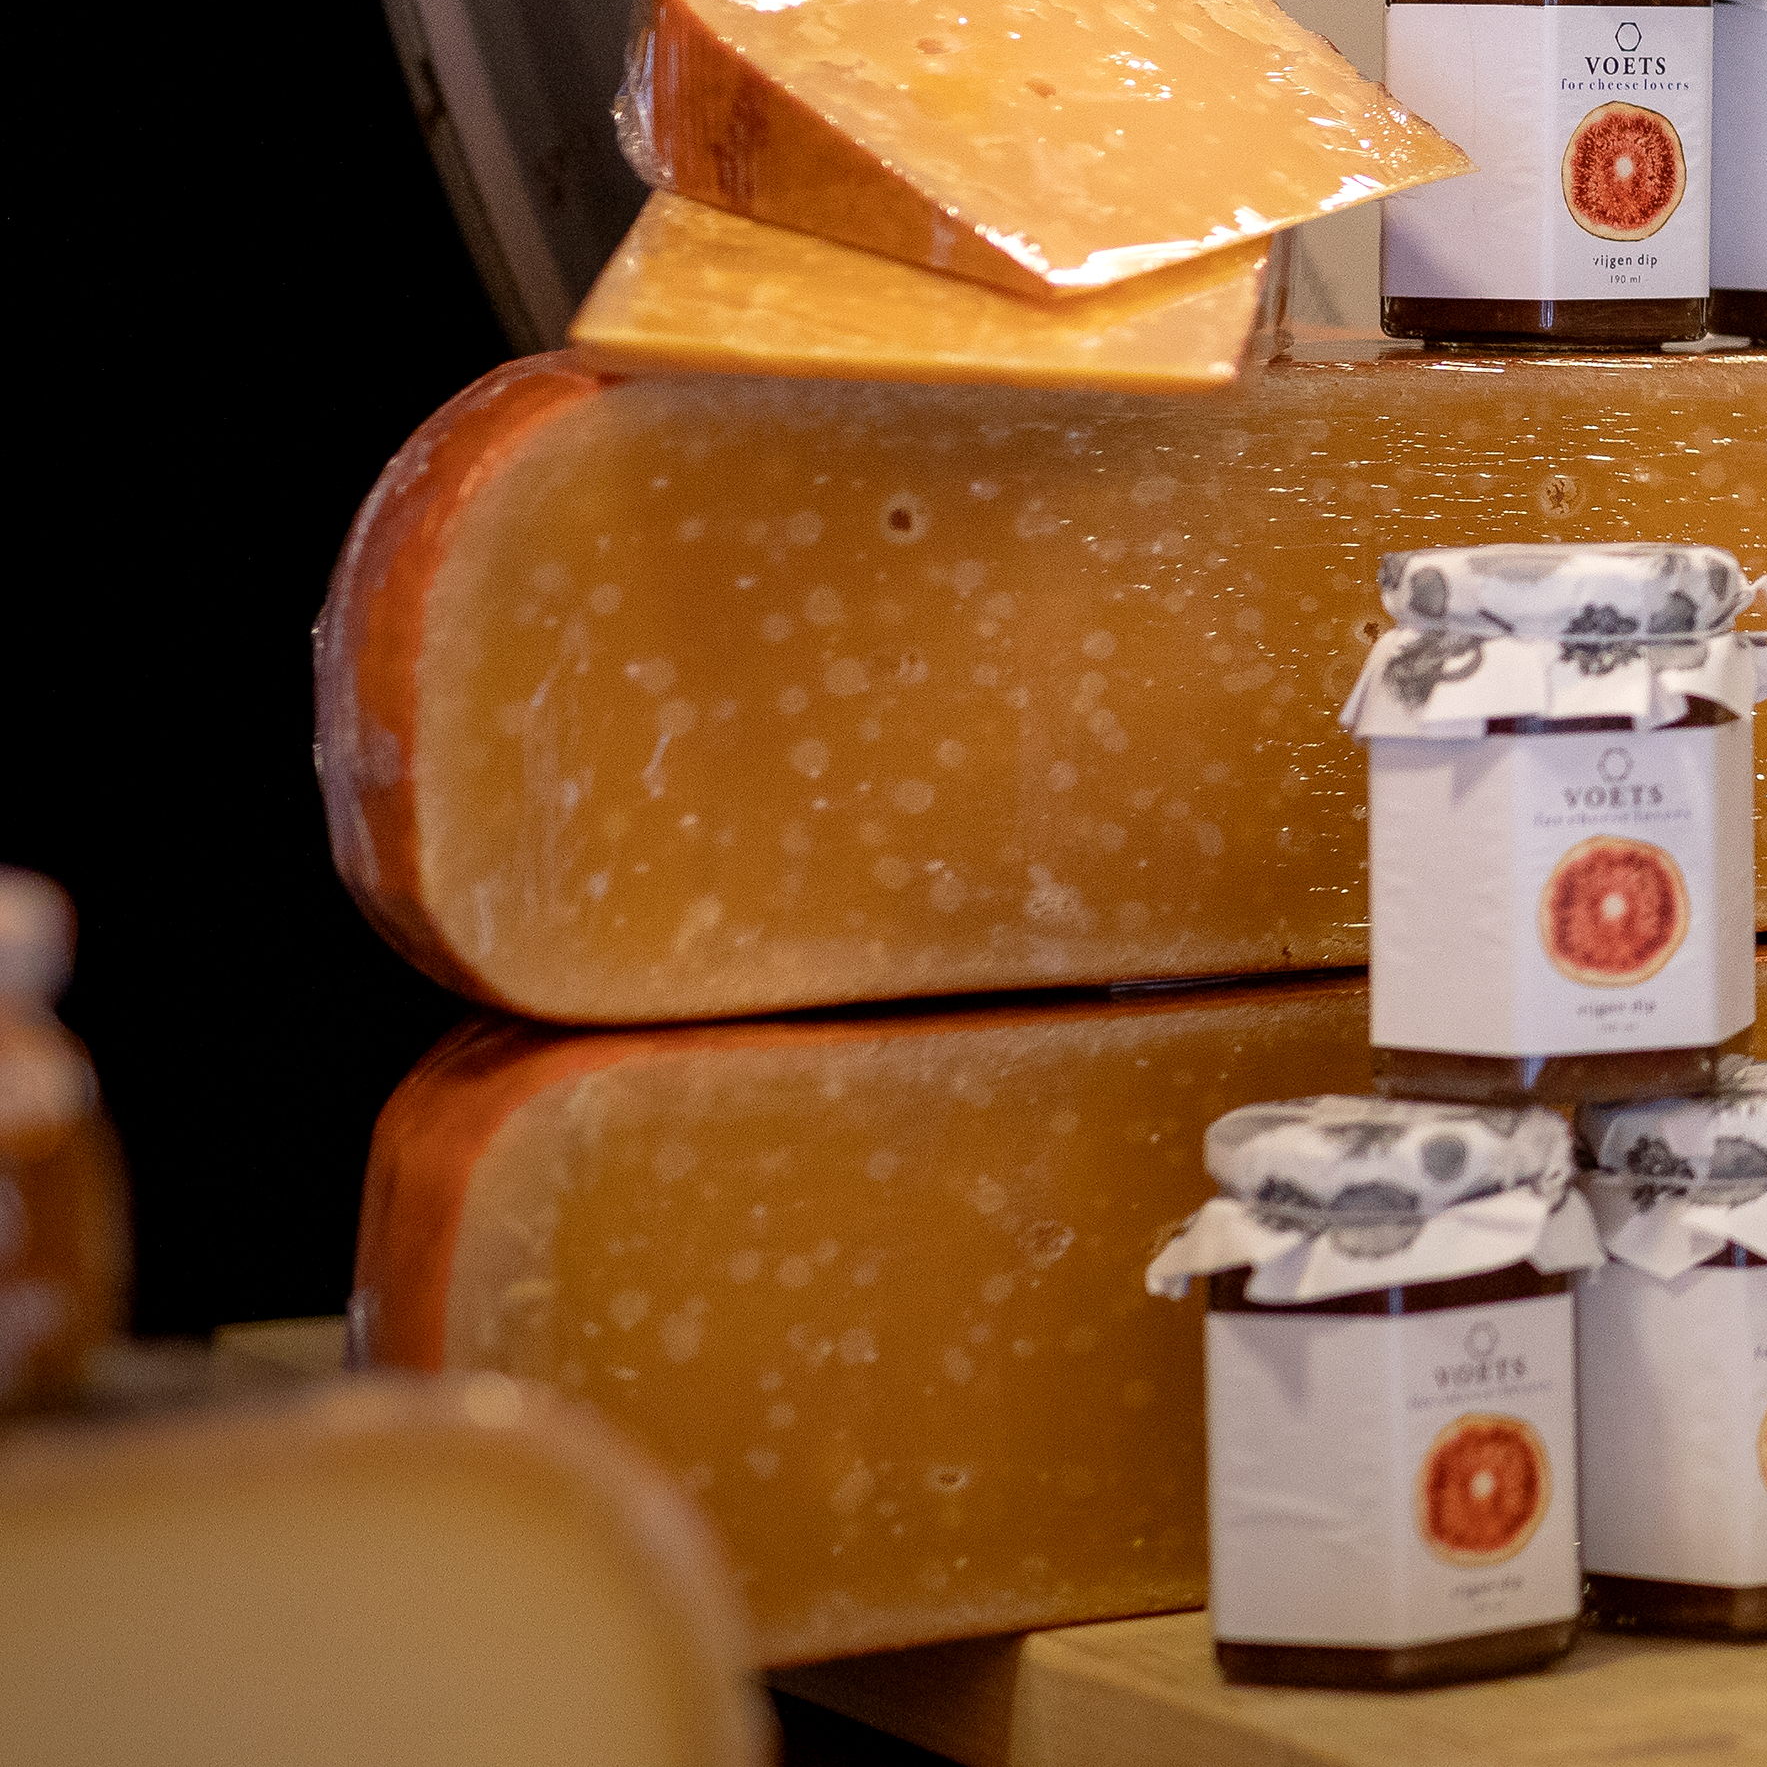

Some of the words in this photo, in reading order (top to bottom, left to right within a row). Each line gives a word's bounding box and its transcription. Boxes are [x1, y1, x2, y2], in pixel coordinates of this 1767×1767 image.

[1584, 56, 1666, 76] VOETS
[1561, 78, 1584, 90] for
[1589, 78, 1639, 91] cheese
[1644, 78, 1690, 91] lovers
[1592, 254, 1632, 269] vijgen
[1637, 253, 1658, 269] dip
[1609, 274, 1626, 284] 190
[1629, 275, 1641, 284] ml
